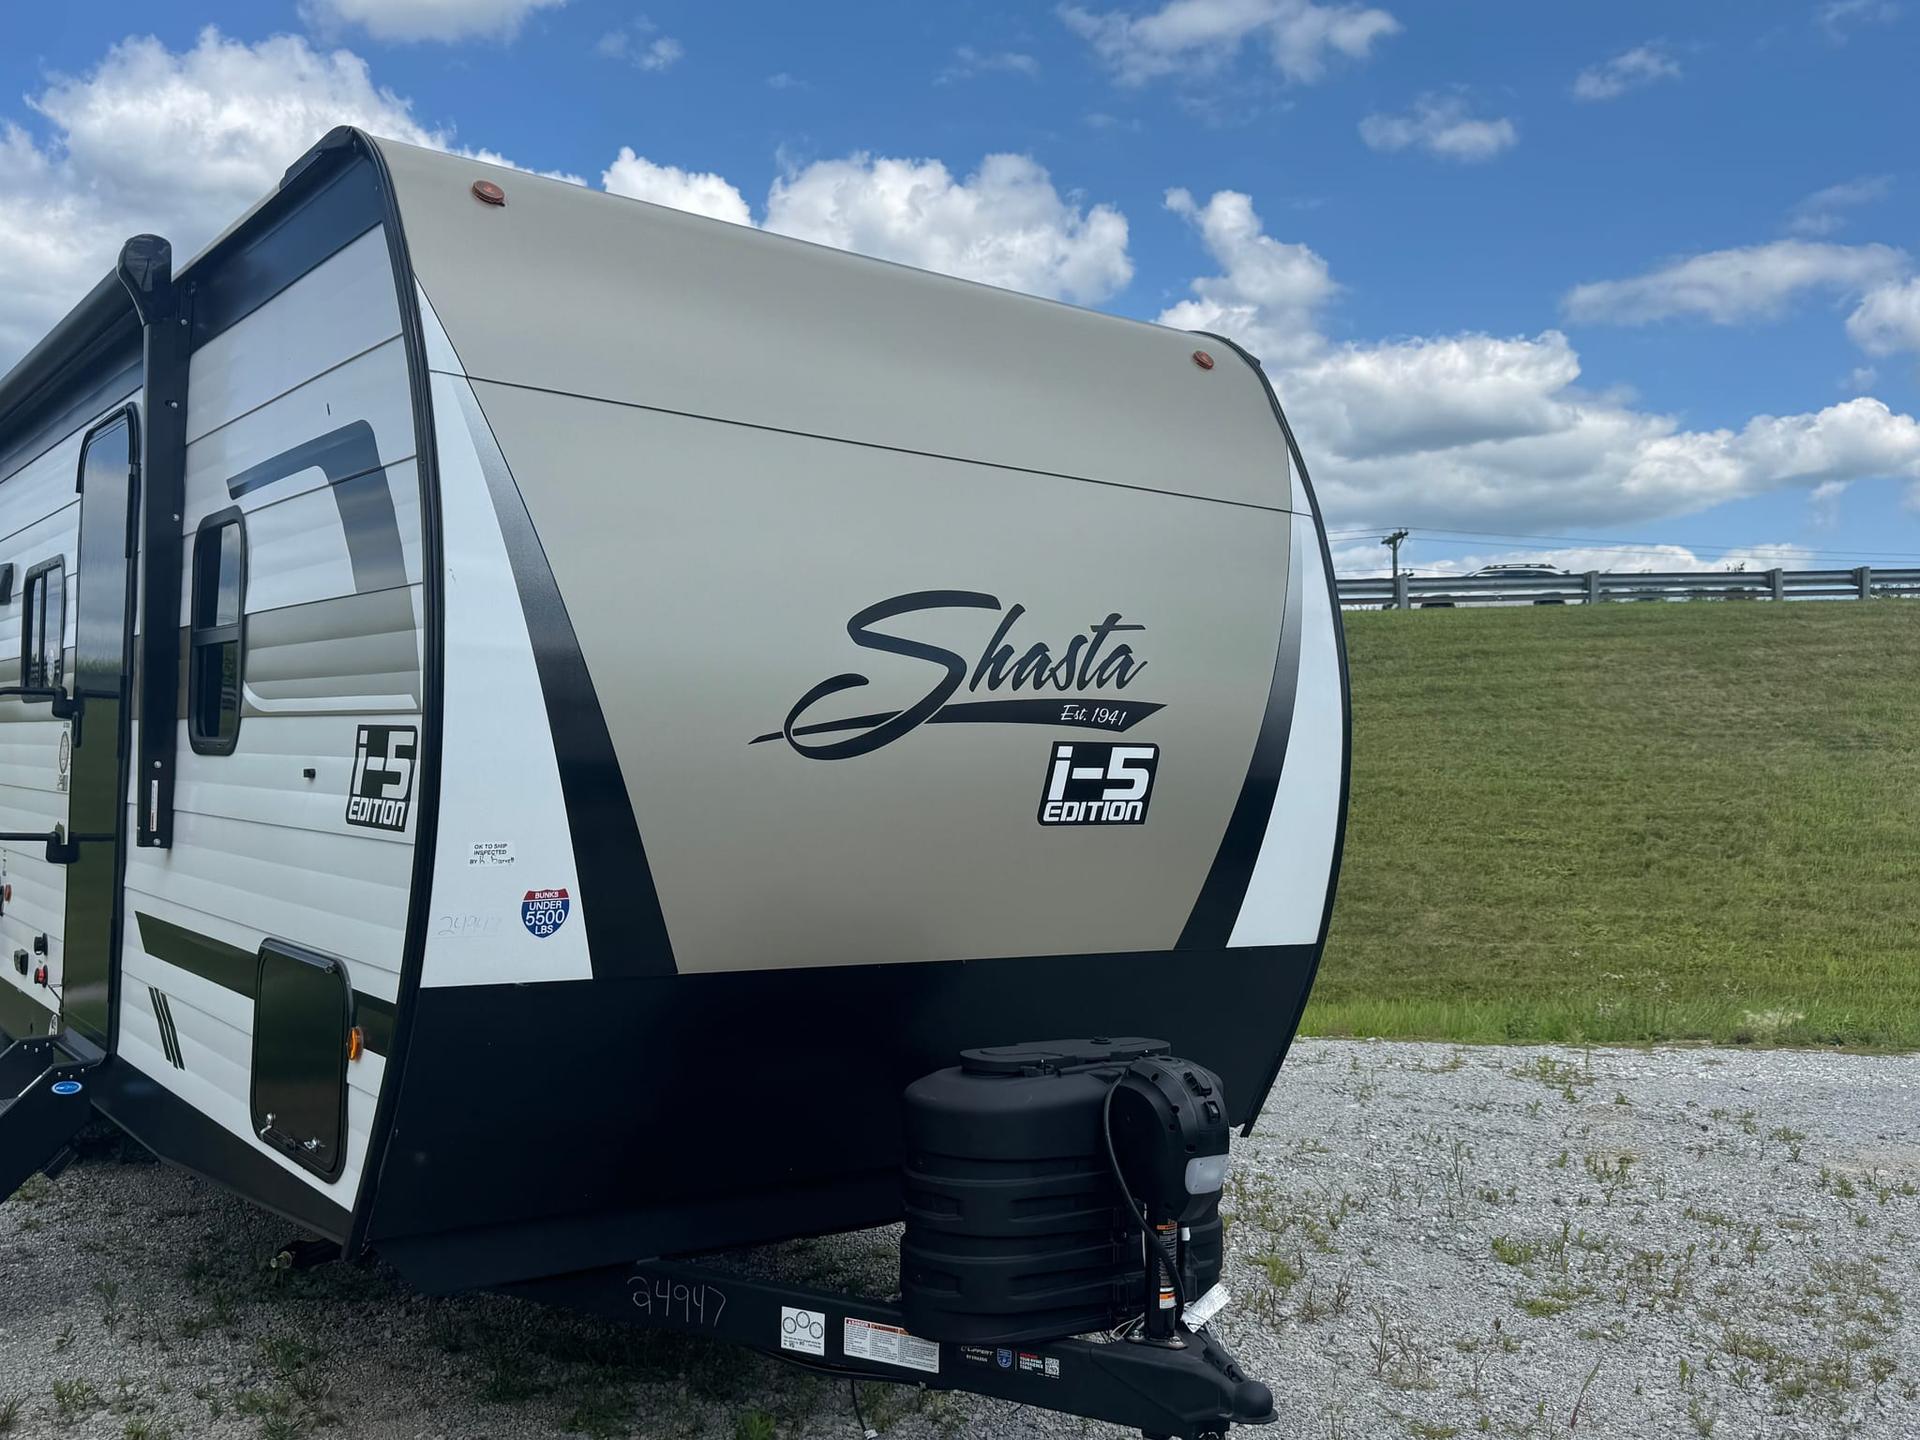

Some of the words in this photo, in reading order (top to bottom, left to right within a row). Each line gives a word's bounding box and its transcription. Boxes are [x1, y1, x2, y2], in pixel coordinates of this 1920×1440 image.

[783, 589, 1148, 761] Shasta
[1060, 704, 1088, 721] Est.
[1091, 707, 1127, 726] 1941
[352, 730, 415, 800] i-5
[1047, 746, 1155, 801] i-5
[348, 796, 406, 827] EDITION
[1043, 801, 1143, 822] EDITION
[529, 900, 562, 911] UNDER
[534, 891, 559, 899] BUNKS
[525, 909, 565, 926] 5500
[535, 924, 554, 935] LBS
[627, 1275, 727, 1328] 24947
